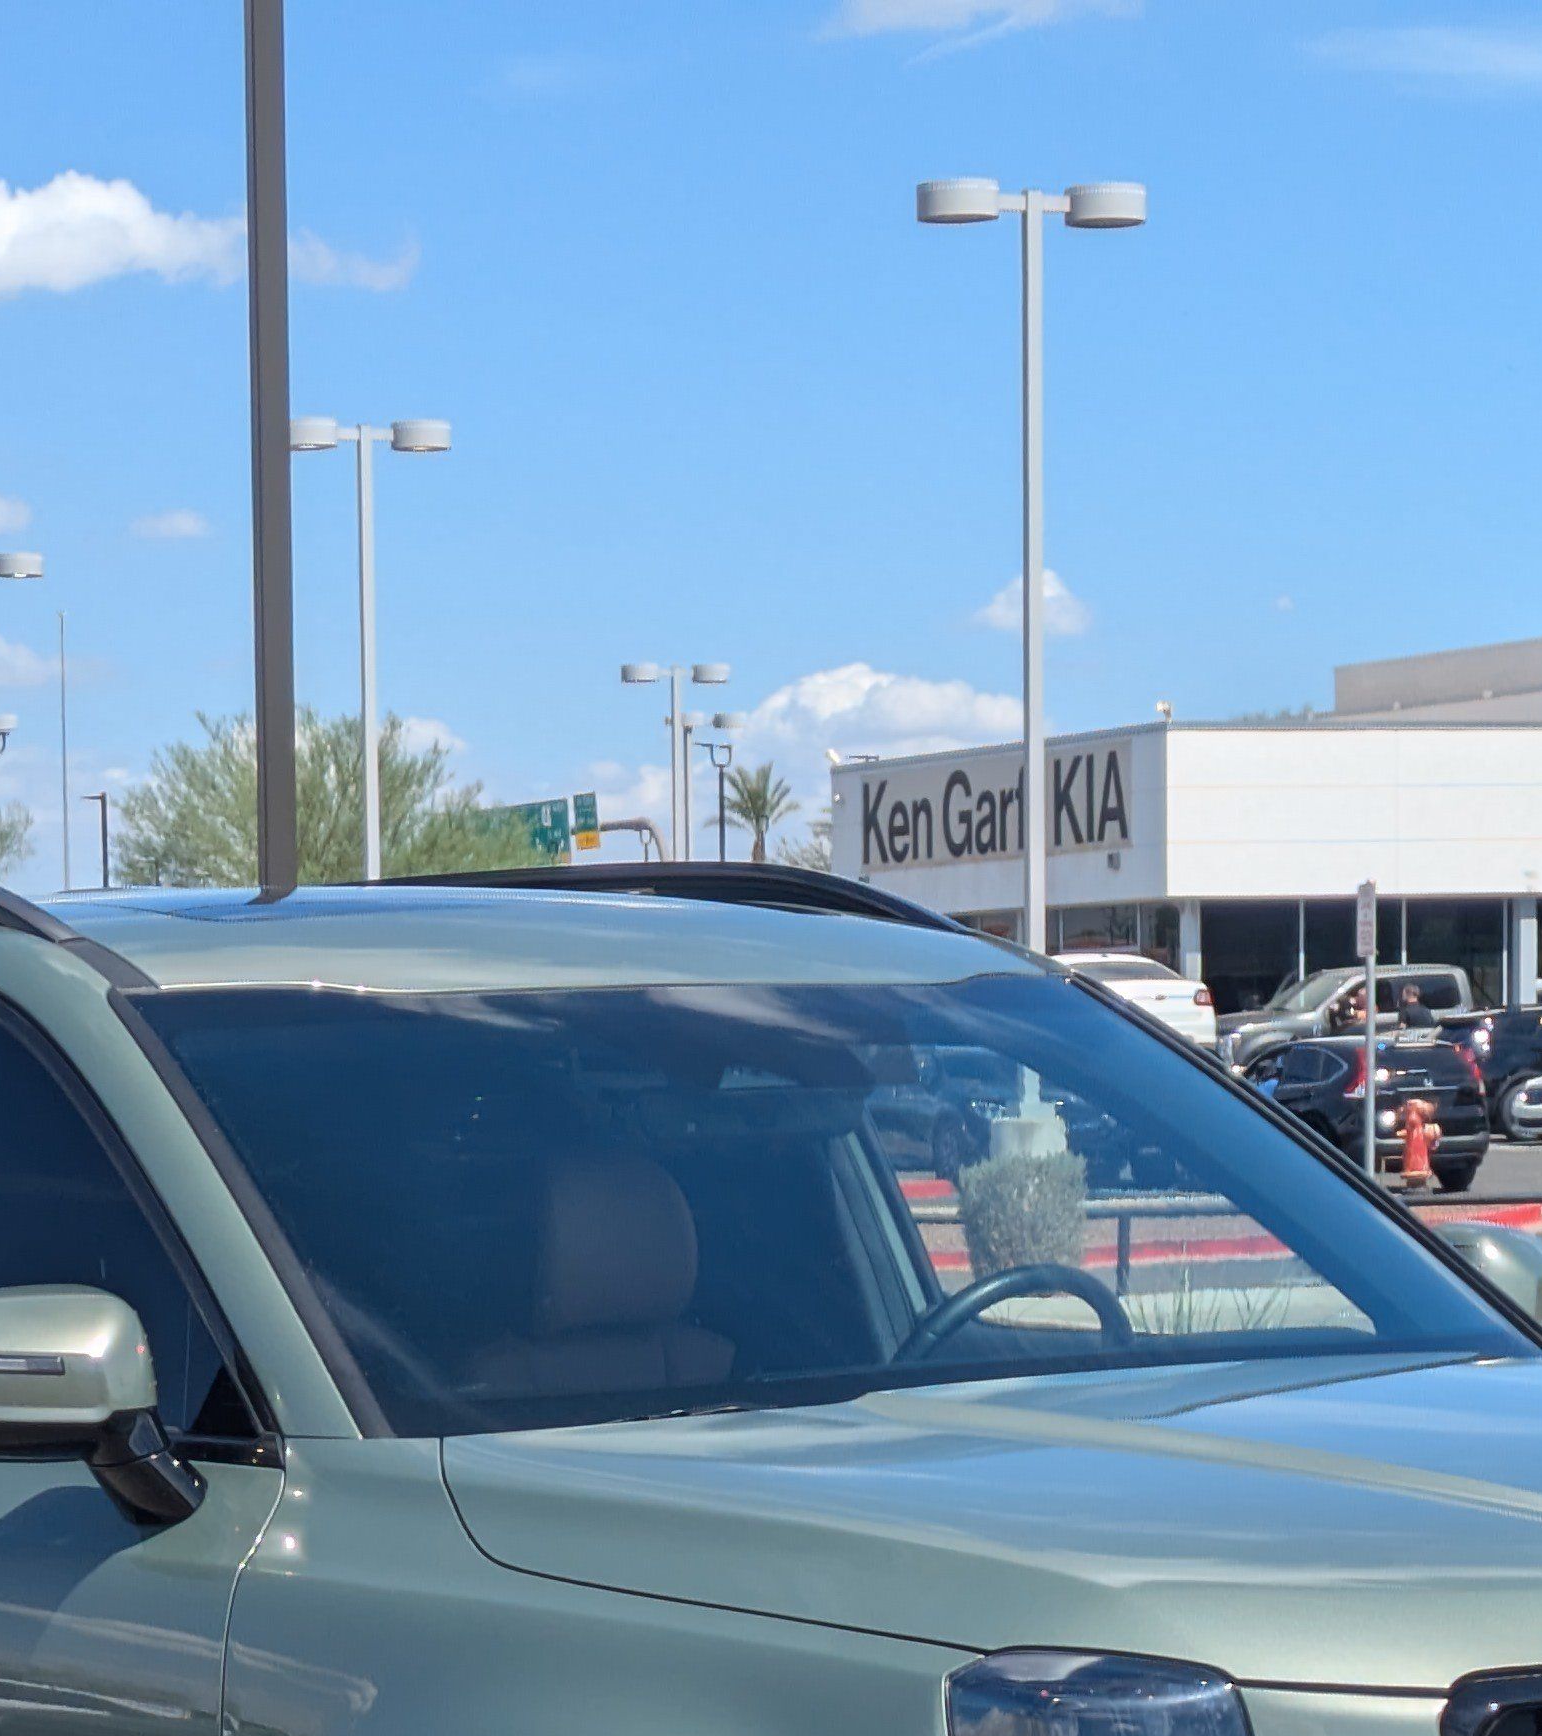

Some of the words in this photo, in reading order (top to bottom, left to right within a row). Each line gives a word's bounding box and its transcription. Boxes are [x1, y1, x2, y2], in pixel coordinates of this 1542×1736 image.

[862, 779, 934, 865] Ken
[942, 766, 1026, 858] Garf
[1053, 750, 1129, 847] KIA
